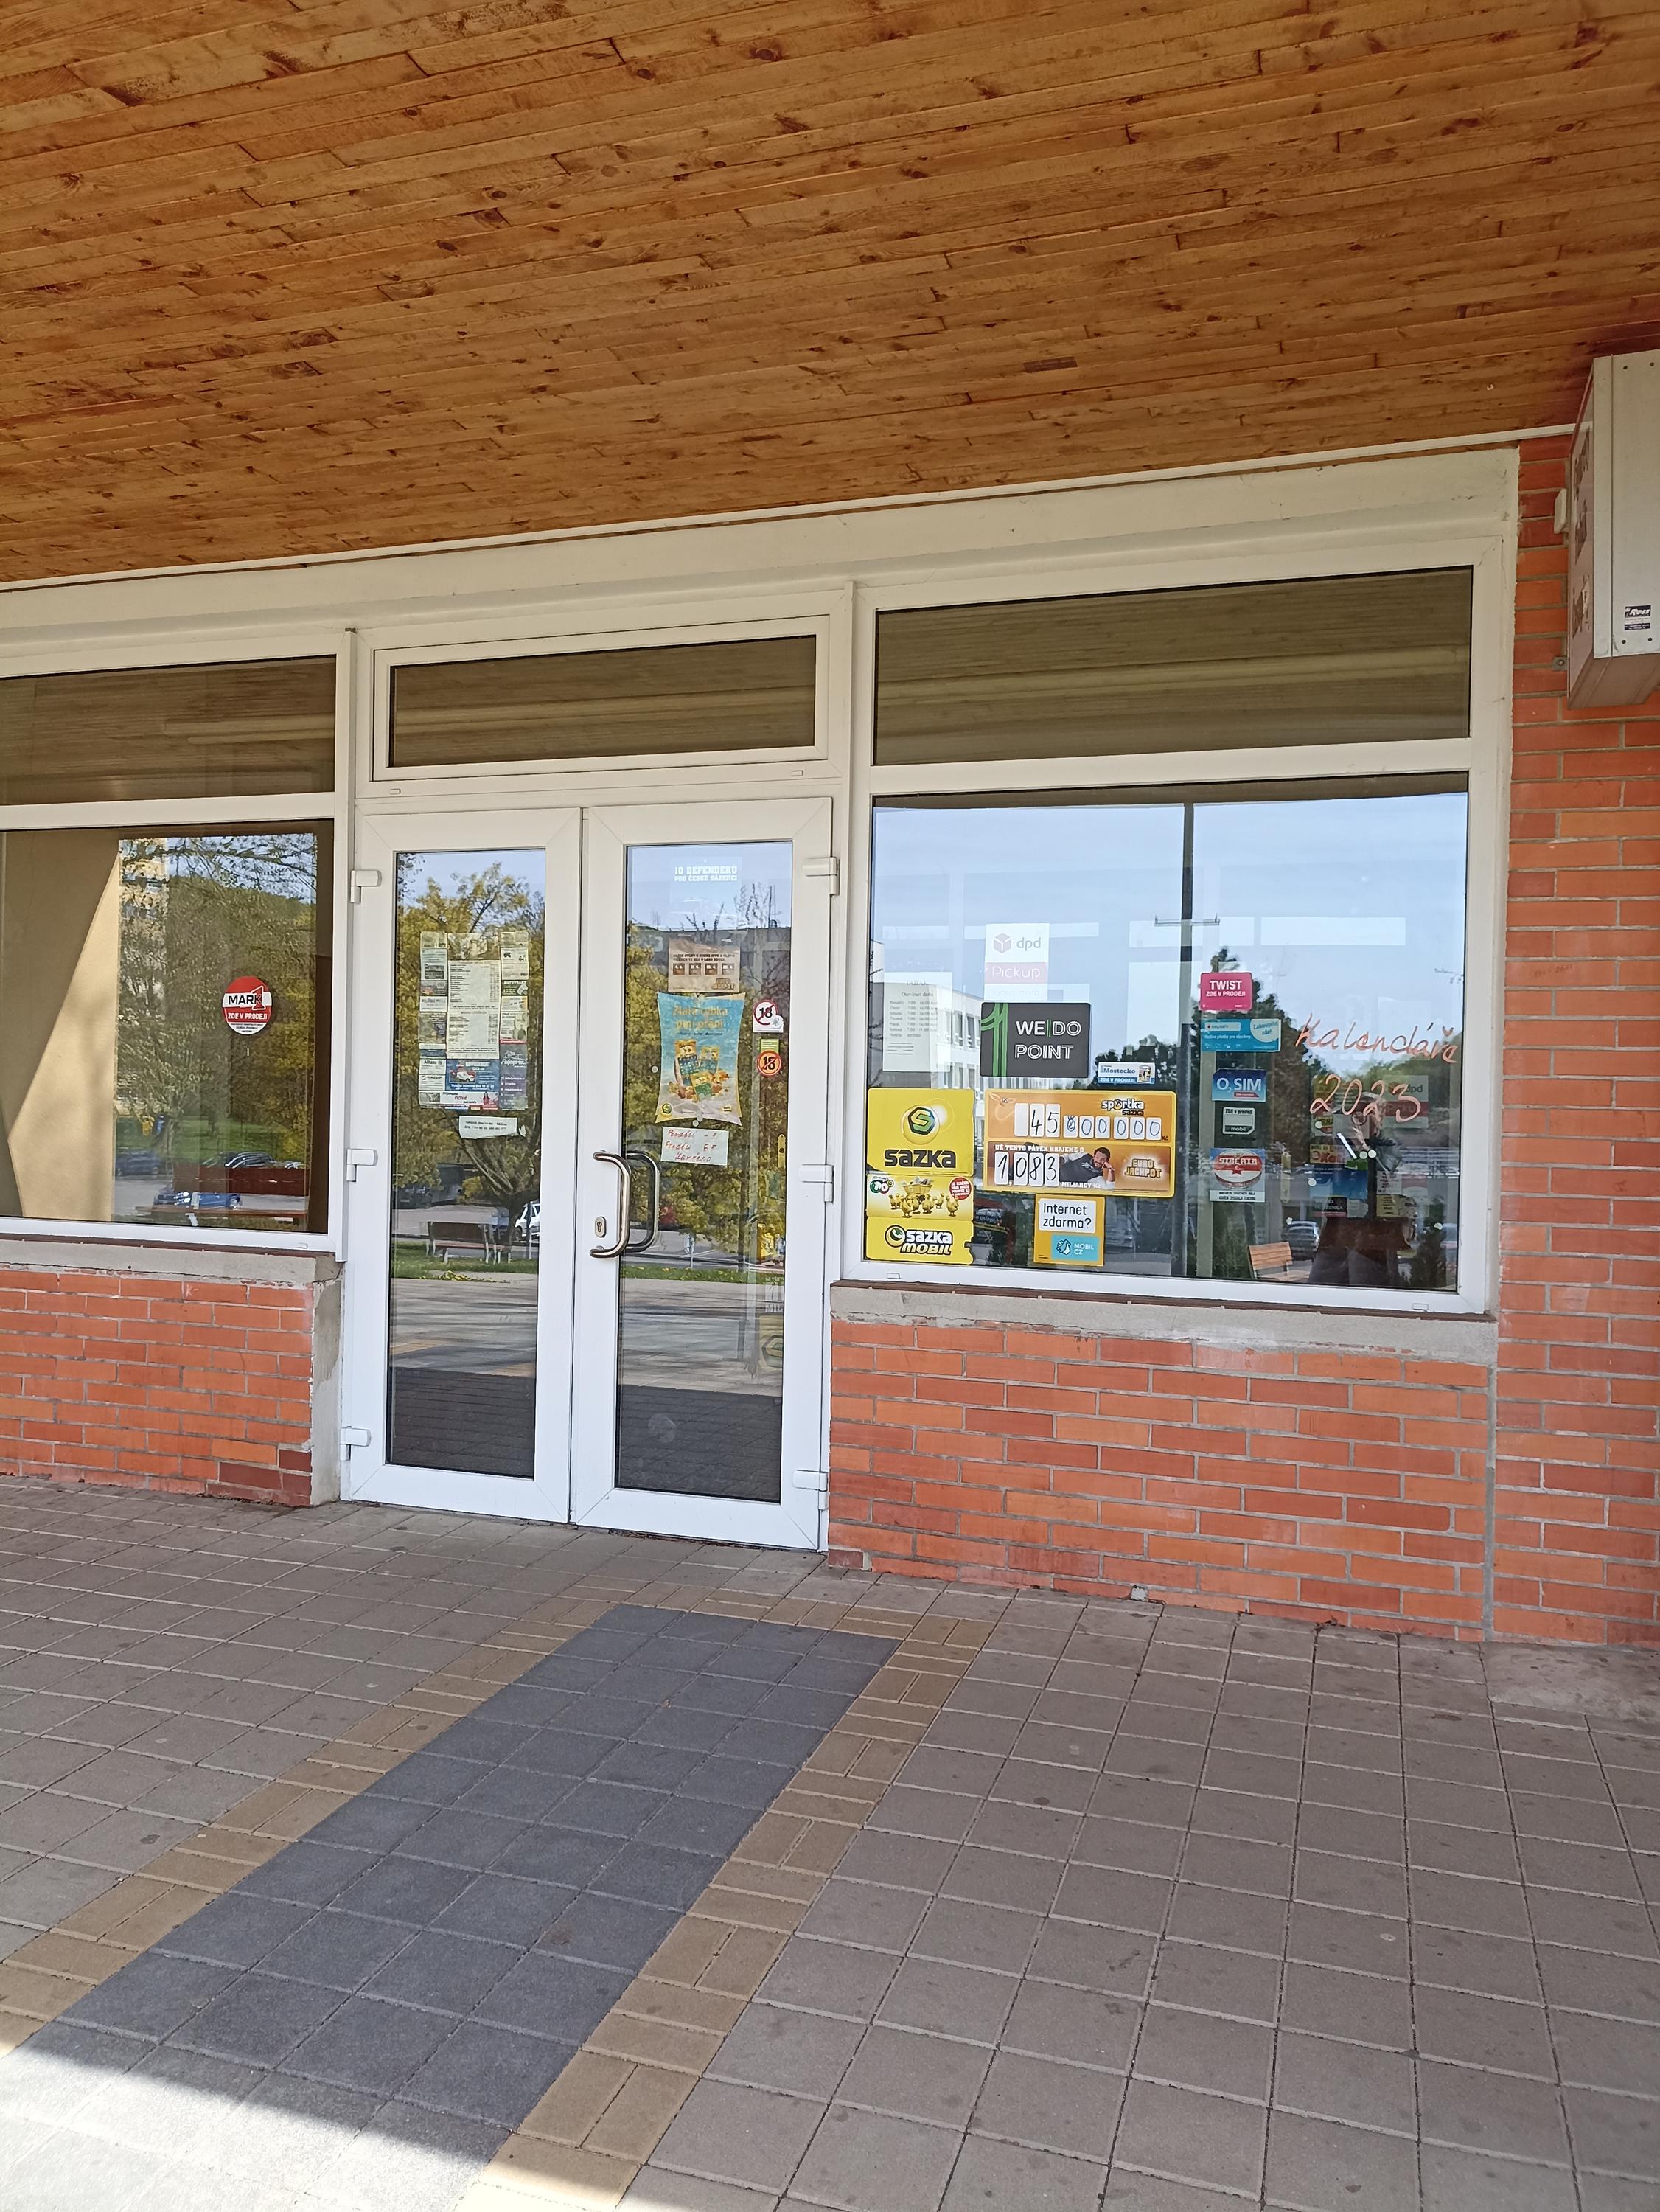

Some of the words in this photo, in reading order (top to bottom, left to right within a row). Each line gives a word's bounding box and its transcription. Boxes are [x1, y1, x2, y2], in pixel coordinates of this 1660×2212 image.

[1016, 937, 1042, 951] dpd
[991, 966, 1041, 980] Pickup
[1210, 981, 1242, 990] TWIST
[760, 1007, 773, 1018] 18
[1014, 1044, 1074, 1060] POINT
[763, 1057, 775, 1070] 18
[1234, 1078, 1262, 1091] SIM
[1309, 1073, 1421, 1122] 2023
[1101, 1098, 1145, 1111] sportka
[1031, 1109, 1059, 1136] 45
[1028, 1144, 1048, 1152] PÁTEK
[1131, 1158, 1155, 1169] EURO
[1125, 1166, 1162, 1178] JACKPOT
[1043, 1203, 1087, 1216] Internet
[1042, 1216, 1092, 1229] zdarma?
[900, 1242, 952, 1256] MOBIL
